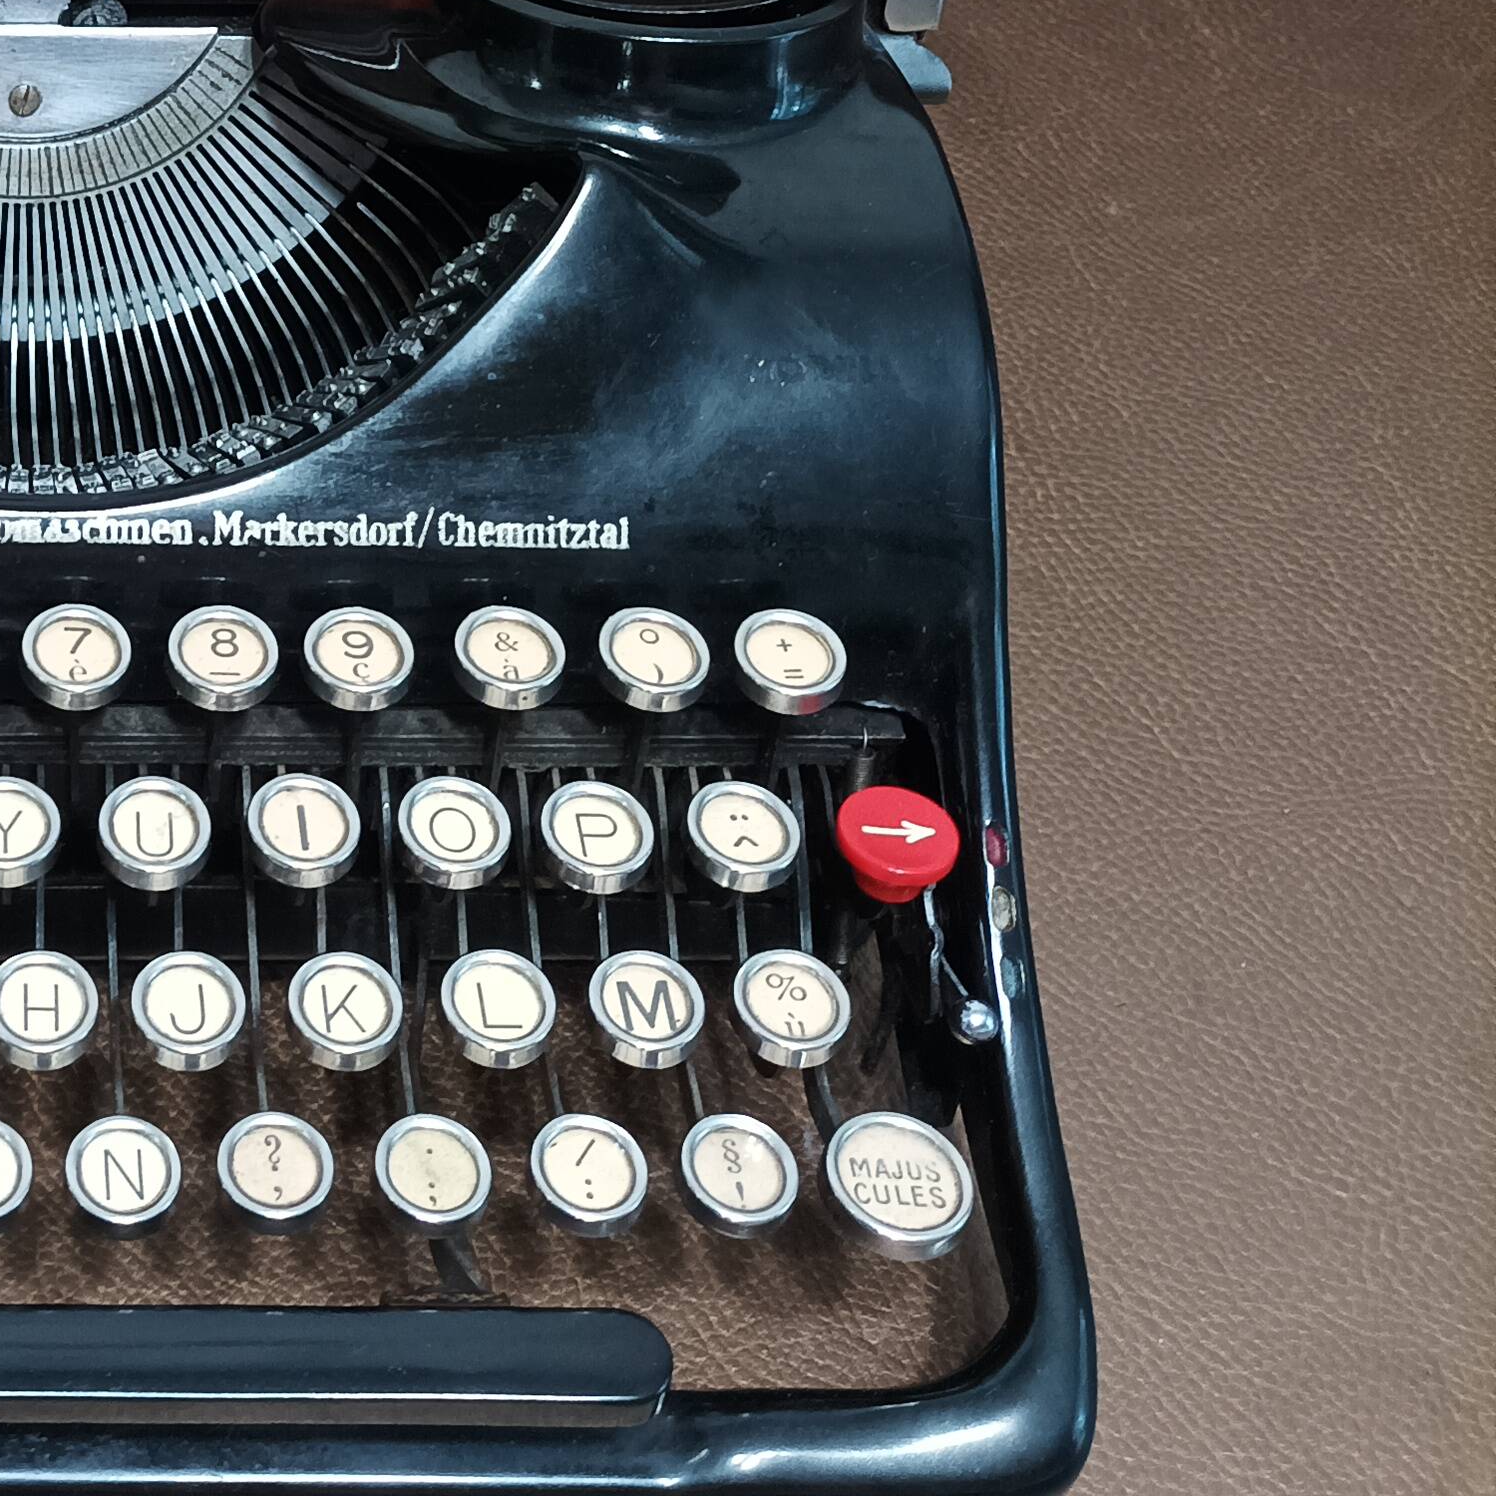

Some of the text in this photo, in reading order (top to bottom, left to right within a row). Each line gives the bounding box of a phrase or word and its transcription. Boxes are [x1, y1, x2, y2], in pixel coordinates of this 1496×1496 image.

[62, 626, 92, 655] 7
[209, 628, 239, 658] 8
[341, 631, 374, 659] 9
[493, 632, 519, 653] &
[775, 637, 793, 653] +
[68, 659, 88, 682] è
[502, 657, 520, 681] à
[655, 662, 665, 684] )
[783, 667, 804, 680] =
[135, 811, 175, 858] U
[296, 804, 310, 851] I
[429, 807, 477, 854] O
[574, 812, 618, 858] P
[764, 972, 808, 1002] %
[22, 982, 60, 1033] H
[169, 983, 206, 1035] J
[320, 983, 367, 1034] K
[476, 982, 523, 1029] L
[615, 980, 679, 1033] M
[263, 1133, 282, 1173] ?
[575, 1139, 596, 1167] /
[720, 1137, 743, 1174] §
[103, 1148, 145, 1201] N
[848, 1156, 942, 1184] MAJUS
[427, 1181, 438, 1207] ;
[583, 1178, 594, 1200] :
[852, 1182, 947, 1209] CULES
